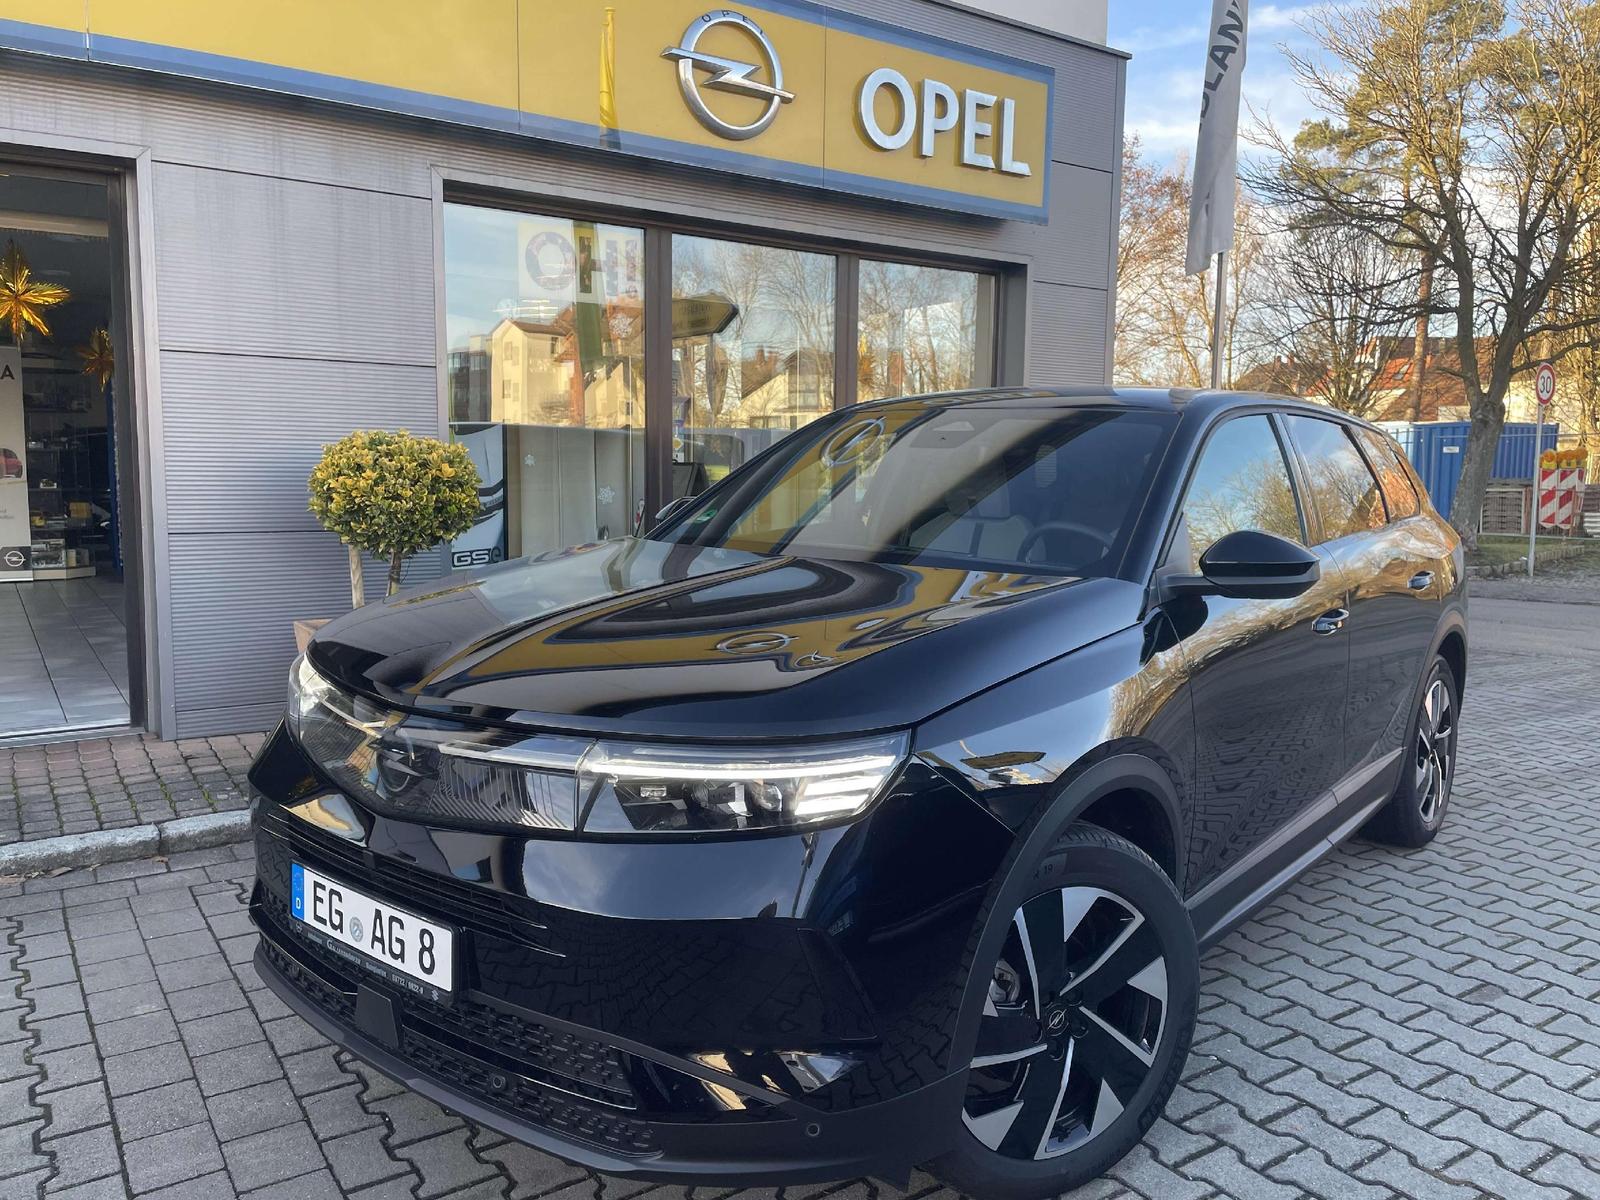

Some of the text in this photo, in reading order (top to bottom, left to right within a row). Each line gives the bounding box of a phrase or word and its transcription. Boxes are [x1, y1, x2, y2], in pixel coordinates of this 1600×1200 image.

[860, 67, 1033, 176] OPEL
[1539, 376, 1552, 394] 30
[295, 897, 301, 910] D
[313, 880, 344, 934] EG
[370, 908, 405, 964] AG
[418, 928, 436, 976] 8
